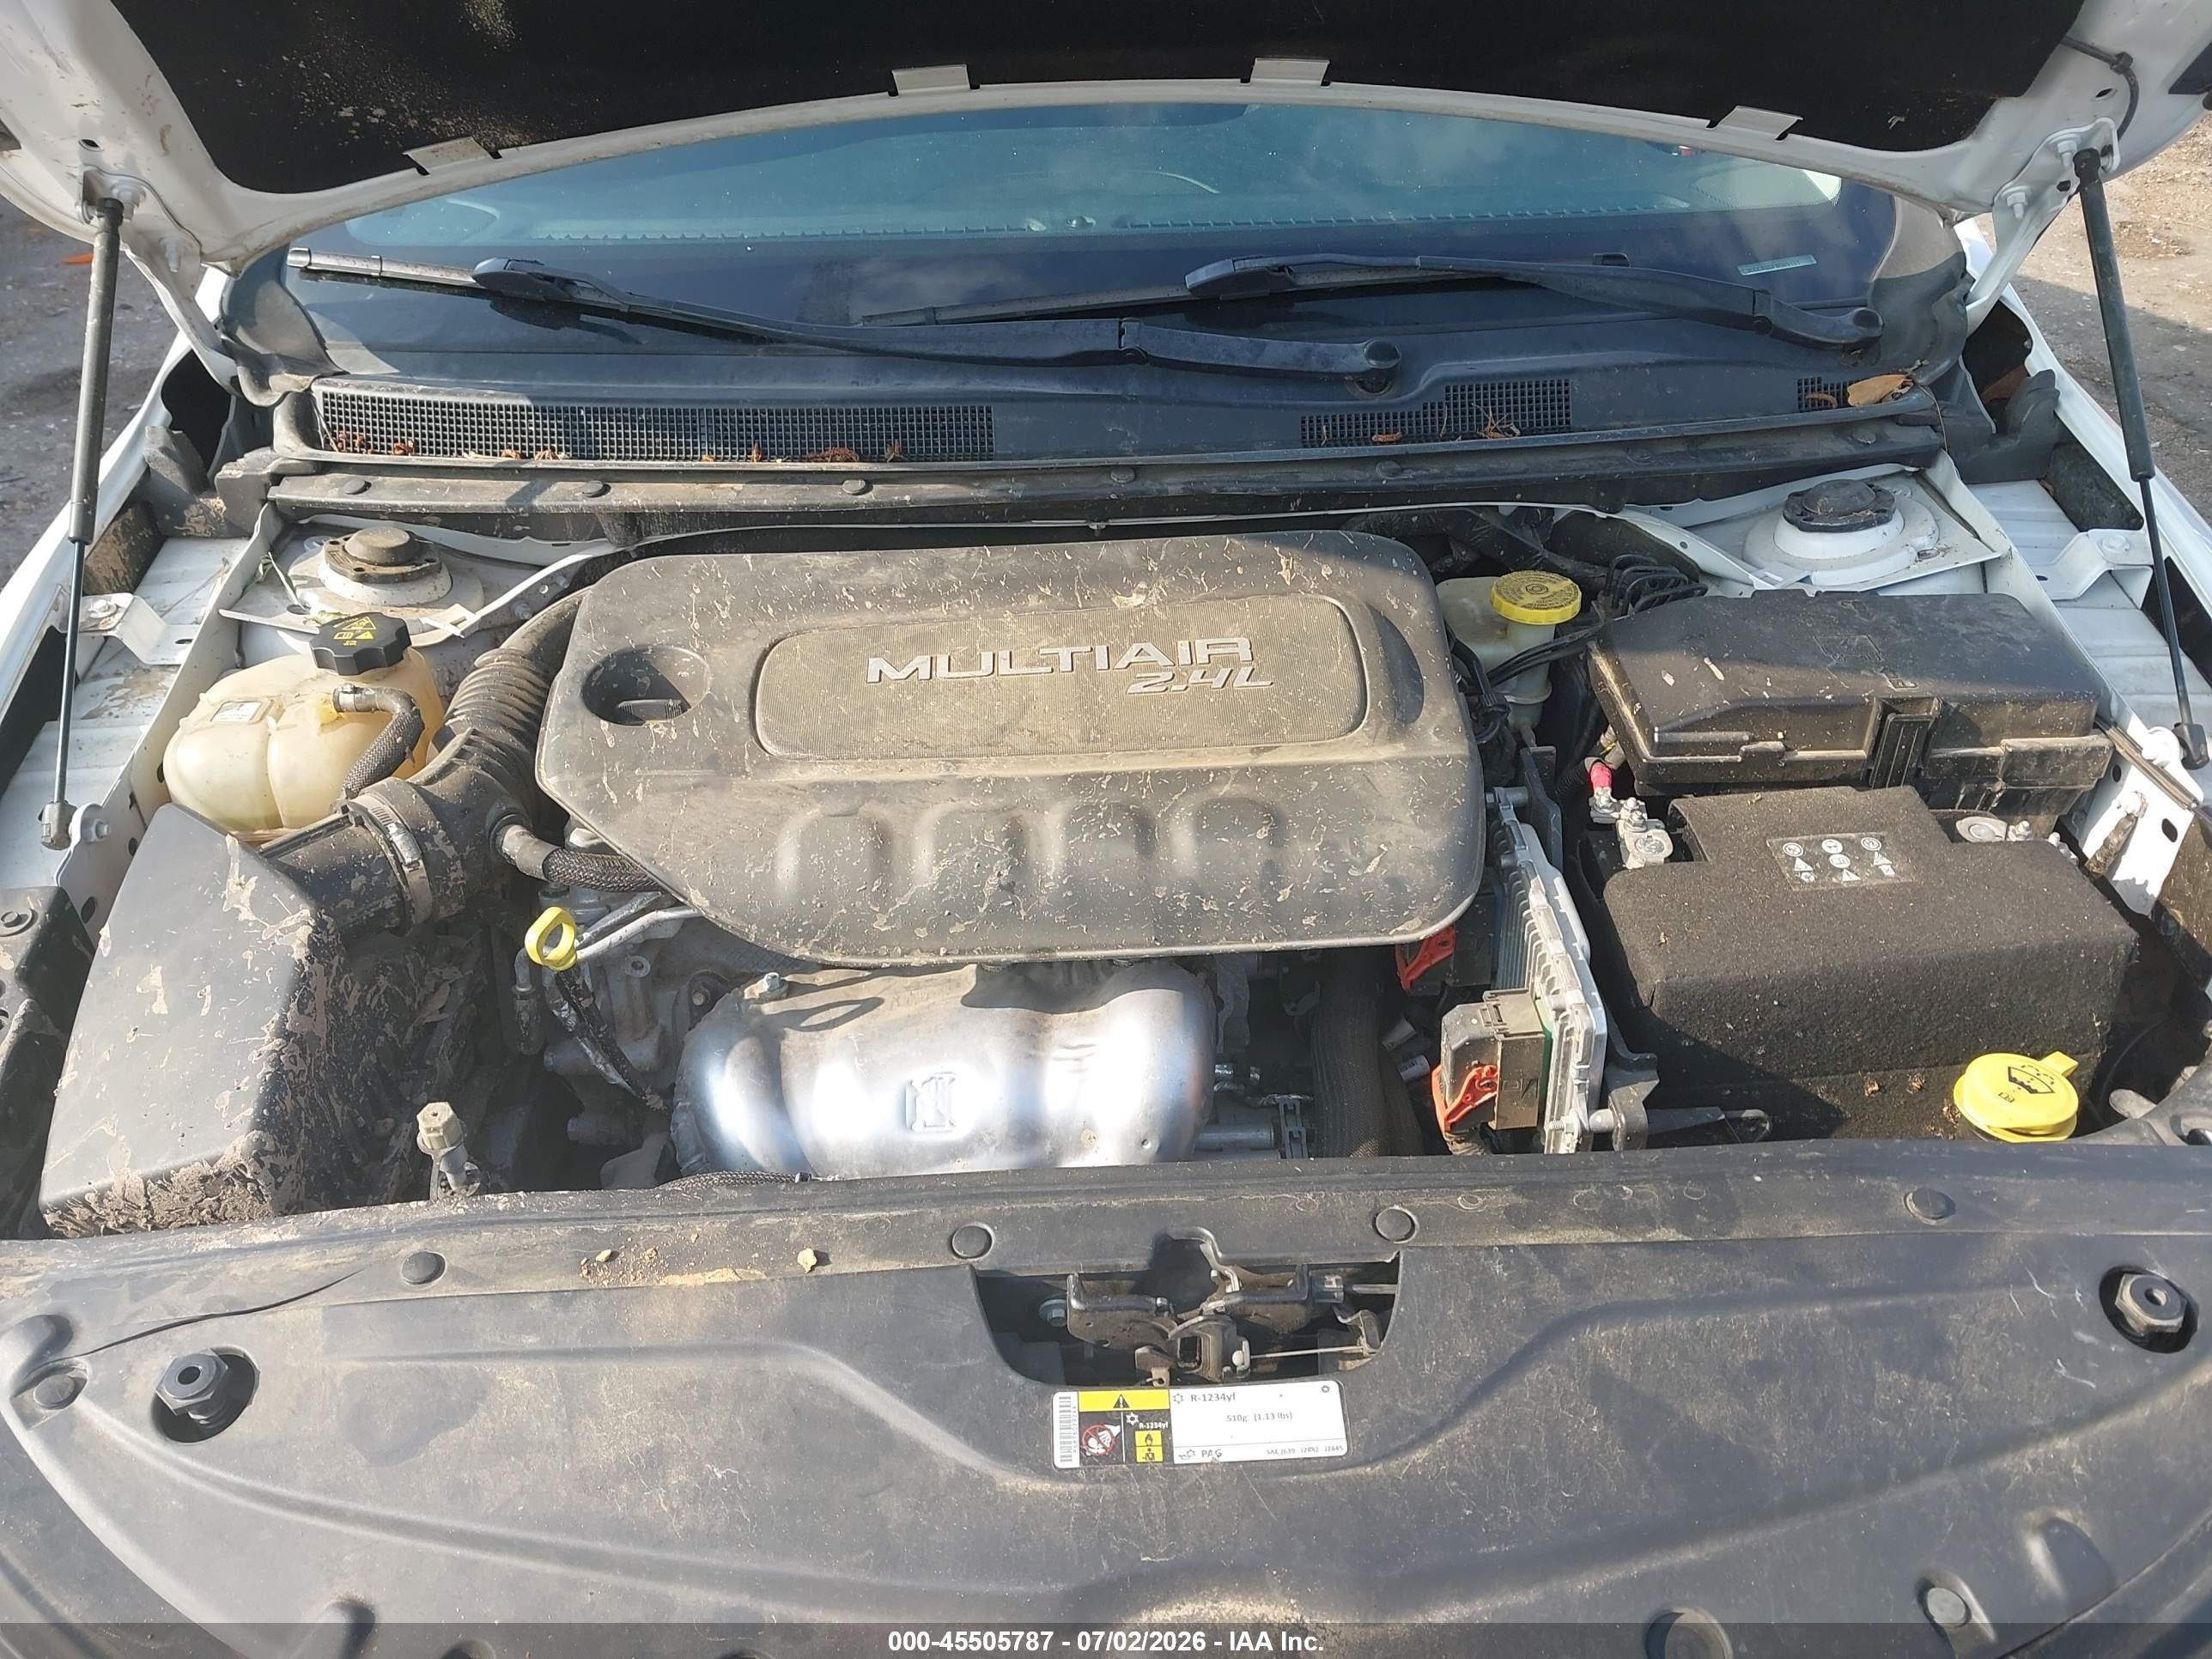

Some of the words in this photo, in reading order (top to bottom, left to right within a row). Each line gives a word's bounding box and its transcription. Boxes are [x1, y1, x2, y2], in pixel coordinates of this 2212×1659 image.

[866, 636, 1255, 684] MULTIAIR
[1127, 666, 1274, 695] 2.4L
[1190, 1392, 1237, 1402] R-1234yf
[1201, 1449, 1223, 1458] PAG
